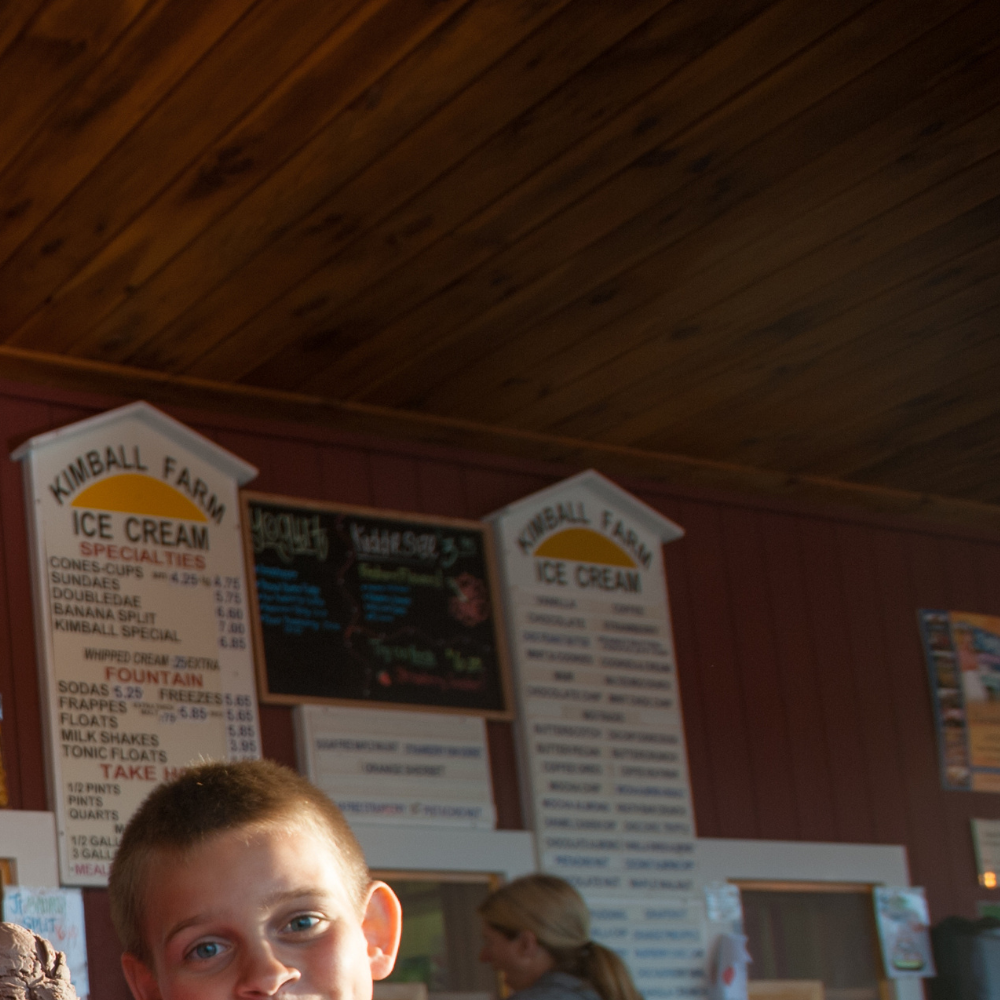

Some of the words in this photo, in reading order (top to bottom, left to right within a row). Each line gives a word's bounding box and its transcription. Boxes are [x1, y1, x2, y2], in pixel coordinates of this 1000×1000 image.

[49, 444, 150, 506] KIMBALL
[163, 455, 228, 525] FARM
[72, 509, 114, 540] ICE
[125, 515, 210, 551] CREAM
[517, 501, 591, 556] KIMBALL
[602, 509, 653, 570] FARM
[80, 541, 206, 571] SPECIALTIES
[50, 556, 144, 579] CONES-CUPS
[535, 559, 568, 586] ICE
[575, 563, 643, 594] CREAM
[51, 572, 120, 591] SUNDAES
[52, 587, 142, 609] DOUBLEDAE
[53, 603, 115, 621] BANANA
[118, 608, 157, 626] SPLIT
[55, 619, 118, 636] KIMBALL
[121, 624, 182, 643] SPECIAL
[84, 648, 131, 664] WHIPPED
[133, 652, 170, 667] CREAM
[104, 666, 203, 688] FOUNTAIN
[58, 681, 109, 698] SODAS
[113, 685, 143, 699] 5.25
[160, 688, 222, 705] FREEZES
[58, 697, 127, 714] FRAPPES
[178, 705, 208, 721] 5.85
[60, 713, 118, 729] FLOATS
[61, 729, 97, 743] MILK
[101, 732, 159, 747] SHAKES
[62, 745, 108, 760] TONIC
[110, 747, 167, 763] FLOATS
[101, 763, 157, 781] TAKE
[68, 782, 84, 795] 1/2
[86, 784, 121, 795] PINTS
[68, 795, 104, 808] PINTS
[69, 808, 119, 821] QUARTS
[71, 835, 88, 847] 1/2
[73, 849, 80, 859] 3
